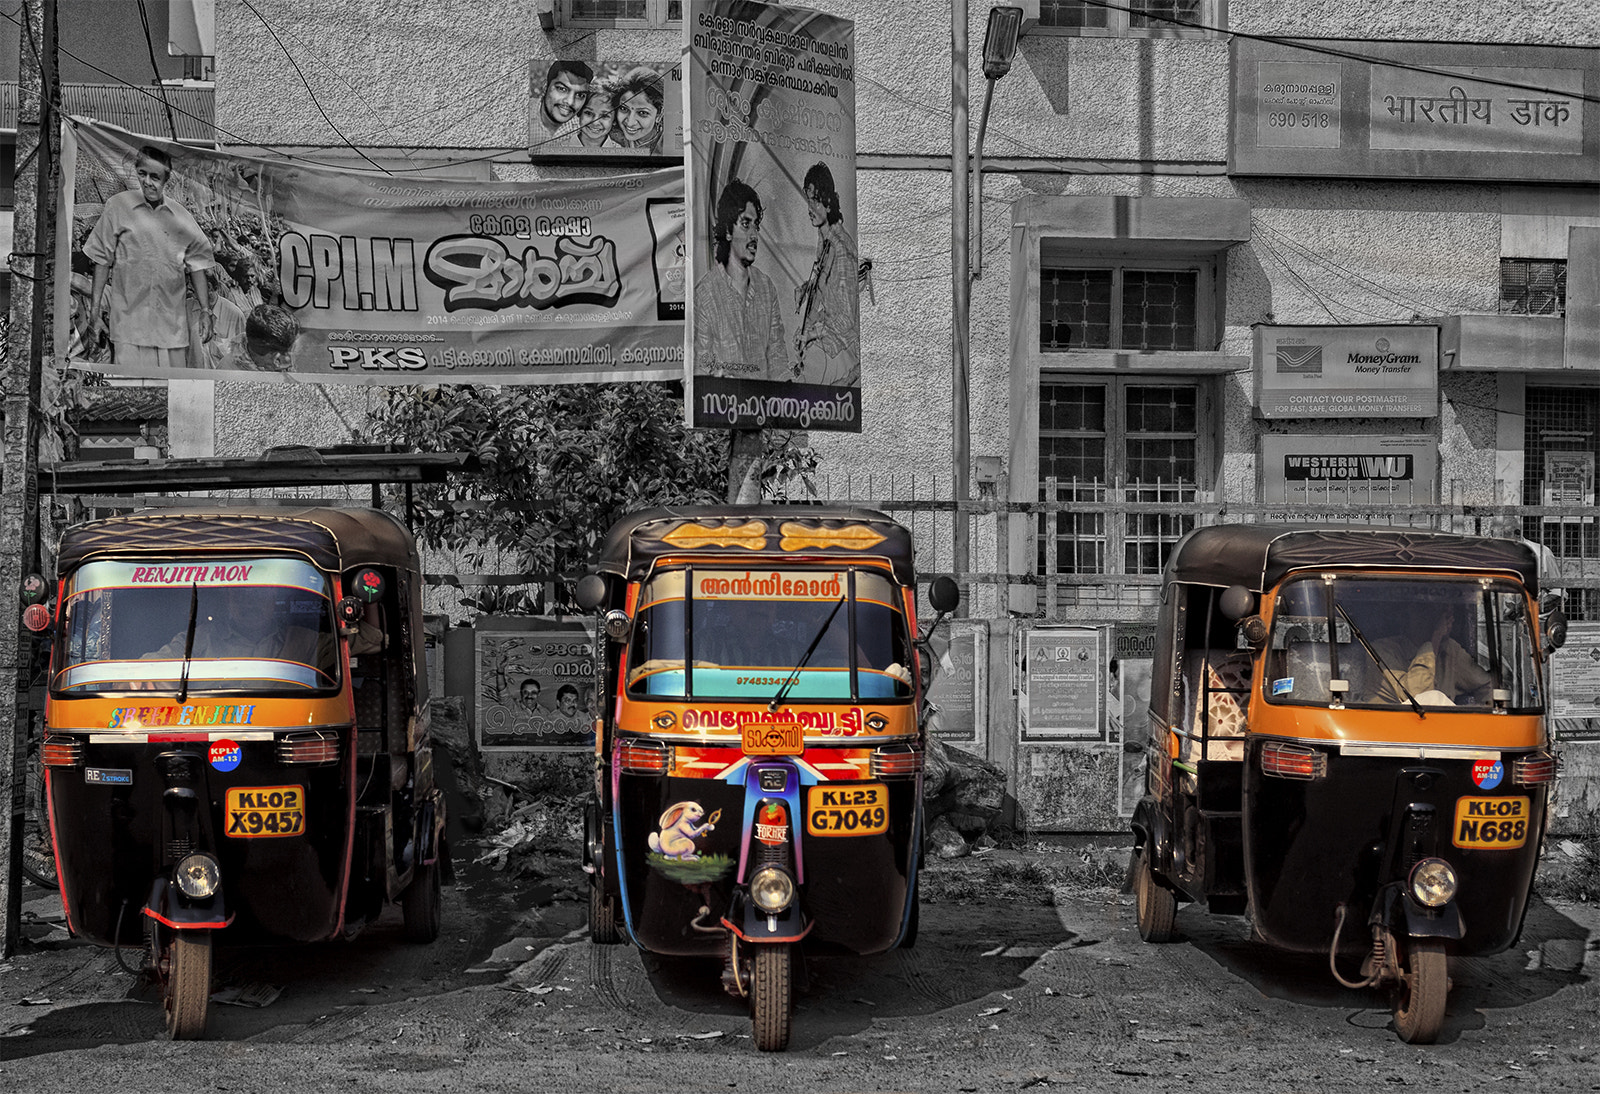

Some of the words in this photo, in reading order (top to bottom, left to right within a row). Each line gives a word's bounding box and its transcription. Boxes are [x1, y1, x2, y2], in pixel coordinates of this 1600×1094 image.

[699, 13, 734, 37] കേരളാ
[711, 59, 742, 78] ഒന്നാം
[764, 49, 795, 74] ബിരുദ
[1263, 82, 1336, 96] കരുനാഗപ്പള്ളി
[1384, 86, 1492, 125] भारतीय
[1507, 97, 1571, 127] डाक
[1269, 112, 1296, 127] 690
[1301, 112, 1329, 128] 518
[541, 199, 603, 211] നയിക്കുന്ന
[470, 214, 531, 239] കേരള
[535, 216, 591, 237] രക്ഷാ
[426, 315, 448, 324] 2014
[328, 346, 428, 371] PKS
[431, 346, 516, 369] പട്ടികജാതി
[1355, 366, 1380, 374] Money
[1382, 365, 1411, 373] Transfer
[1289, 395, 1329, 404] CONTACT
[1331, 395, 1354, 403] YOUR
[1355, 395, 1408, 403] POSTMASTER
[702, 391, 855, 428] സുഹൃത്തുക്കൾ
[1290, 405, 1307, 413] FAST,
[1308, 405, 1327, 413] SAFE,
[1288, 456, 1358, 467] WESTERN
[1365, 456, 1406, 478] WU
[1310, 467, 1358, 478] UNION
[131, 566, 209, 583] RENJITH
[210, 565, 253, 581] MON
[700, 571, 840, 596] അൻസിമോൾ
[736, 677, 800, 685] 9745334770
[210, 747, 239, 755] KPLY
[87, 770, 100, 780] RE
